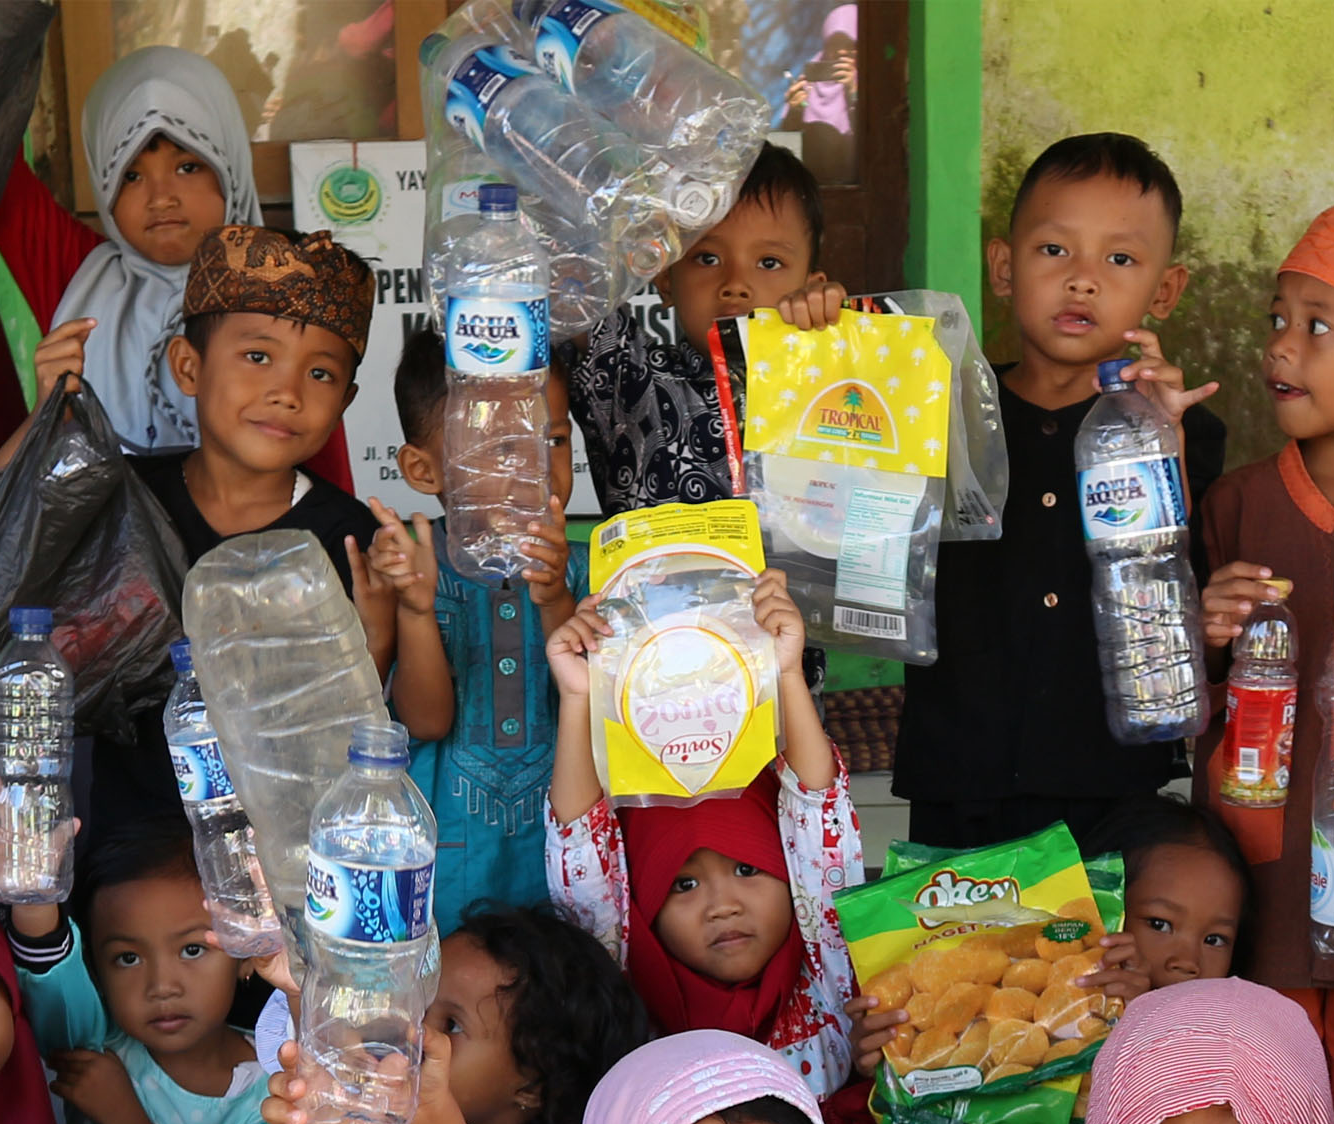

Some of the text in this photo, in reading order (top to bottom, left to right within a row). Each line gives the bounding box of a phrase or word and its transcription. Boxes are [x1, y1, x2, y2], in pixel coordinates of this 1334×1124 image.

[396, 170, 428, 191] YAY
[376, 268, 423, 304] PEN
[455, 313, 520, 343] AQUA
[820, 408, 882, 431] TROPICAL
[388, 446, 399, 460] R
[380, 466, 405, 480] Ds.
[1086, 476, 1147, 506] AQUA
[667, 737, 723, 762] Sovia
[172, 755, 193, 777] UA
[307, 860, 339, 901] QUA
[914, 924, 976, 950] NAGET
